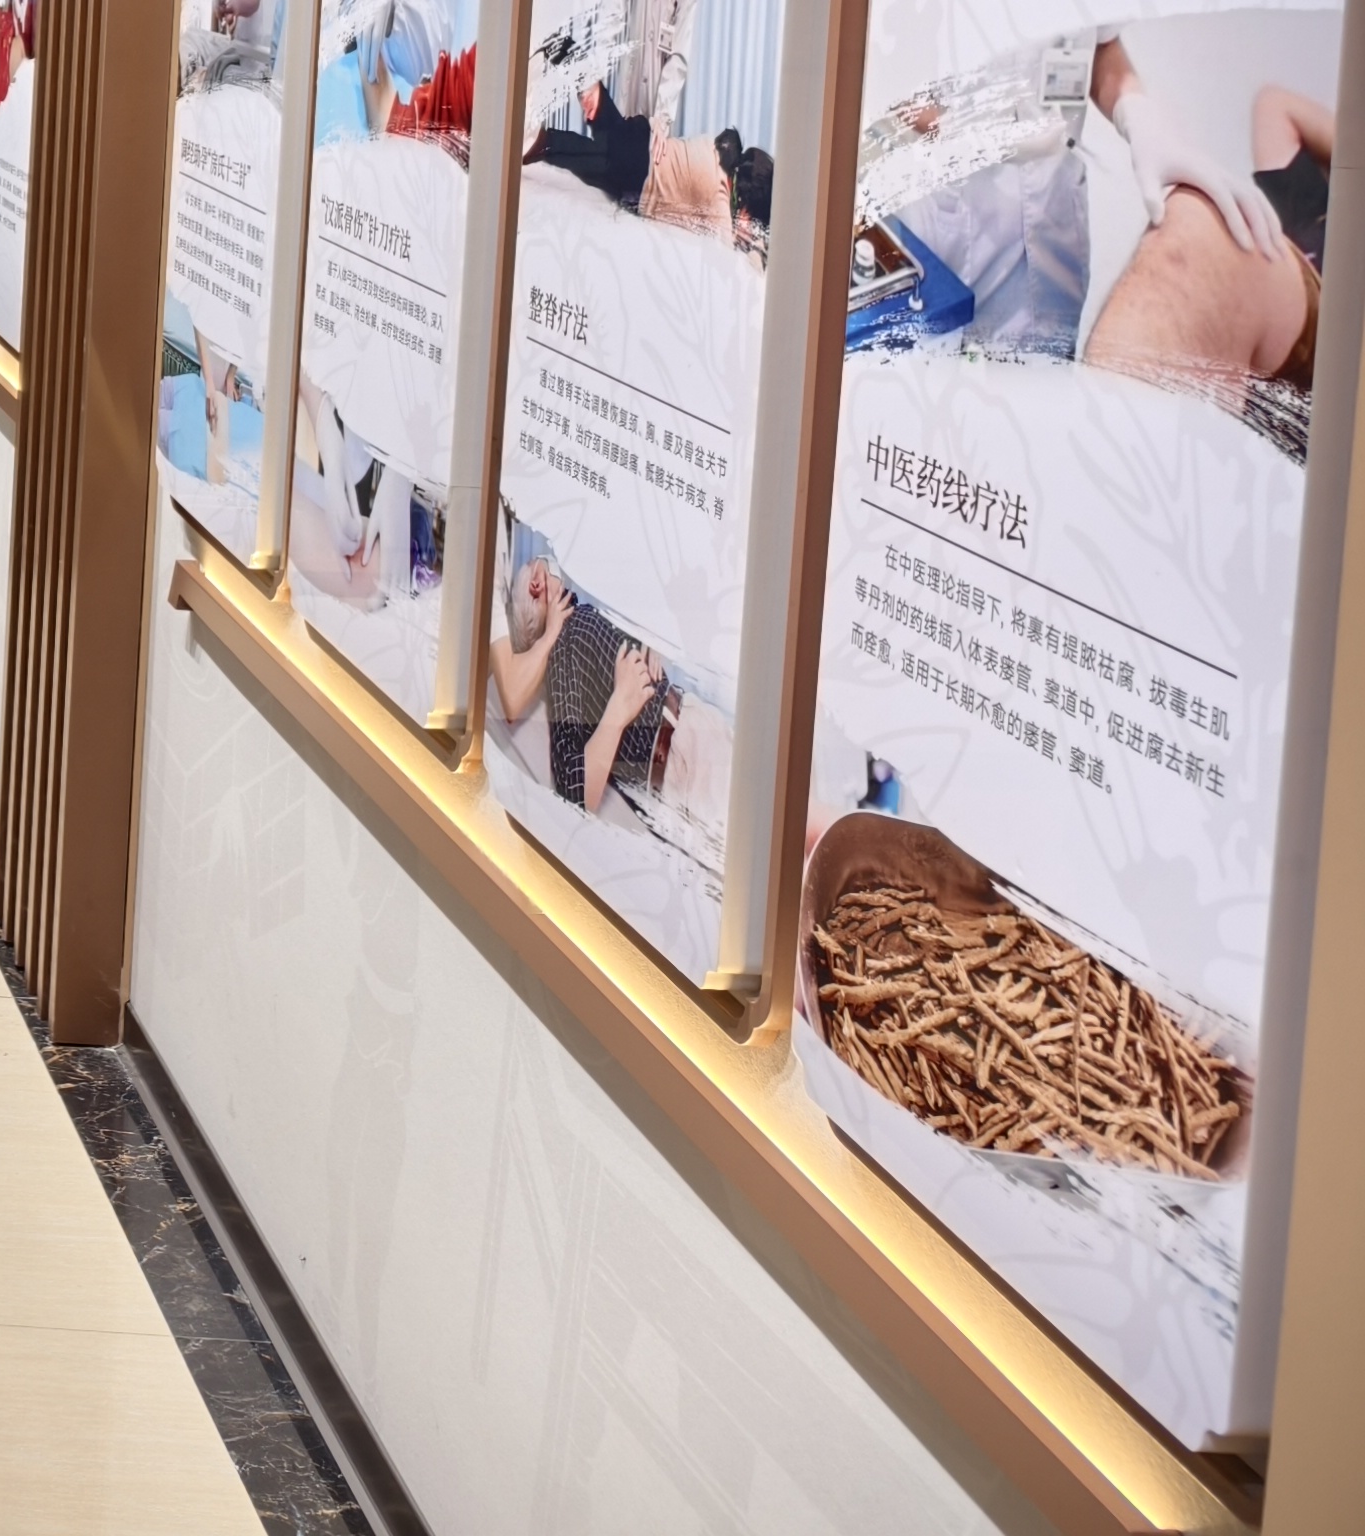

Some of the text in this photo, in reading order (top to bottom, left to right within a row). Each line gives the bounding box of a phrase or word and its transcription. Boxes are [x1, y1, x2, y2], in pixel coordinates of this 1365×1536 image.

[528, 285, 588, 345] 整脊疗法
[866, 434, 1028, 550] 中医药线疗法
[850, 622, 1113, 795] 而痊愈，适用于长期不愈的瘘管、窦道。
[884, 544, 1230, 741] 在中医理论指导下，将裹有提脓祛腐、拔毒生肌
